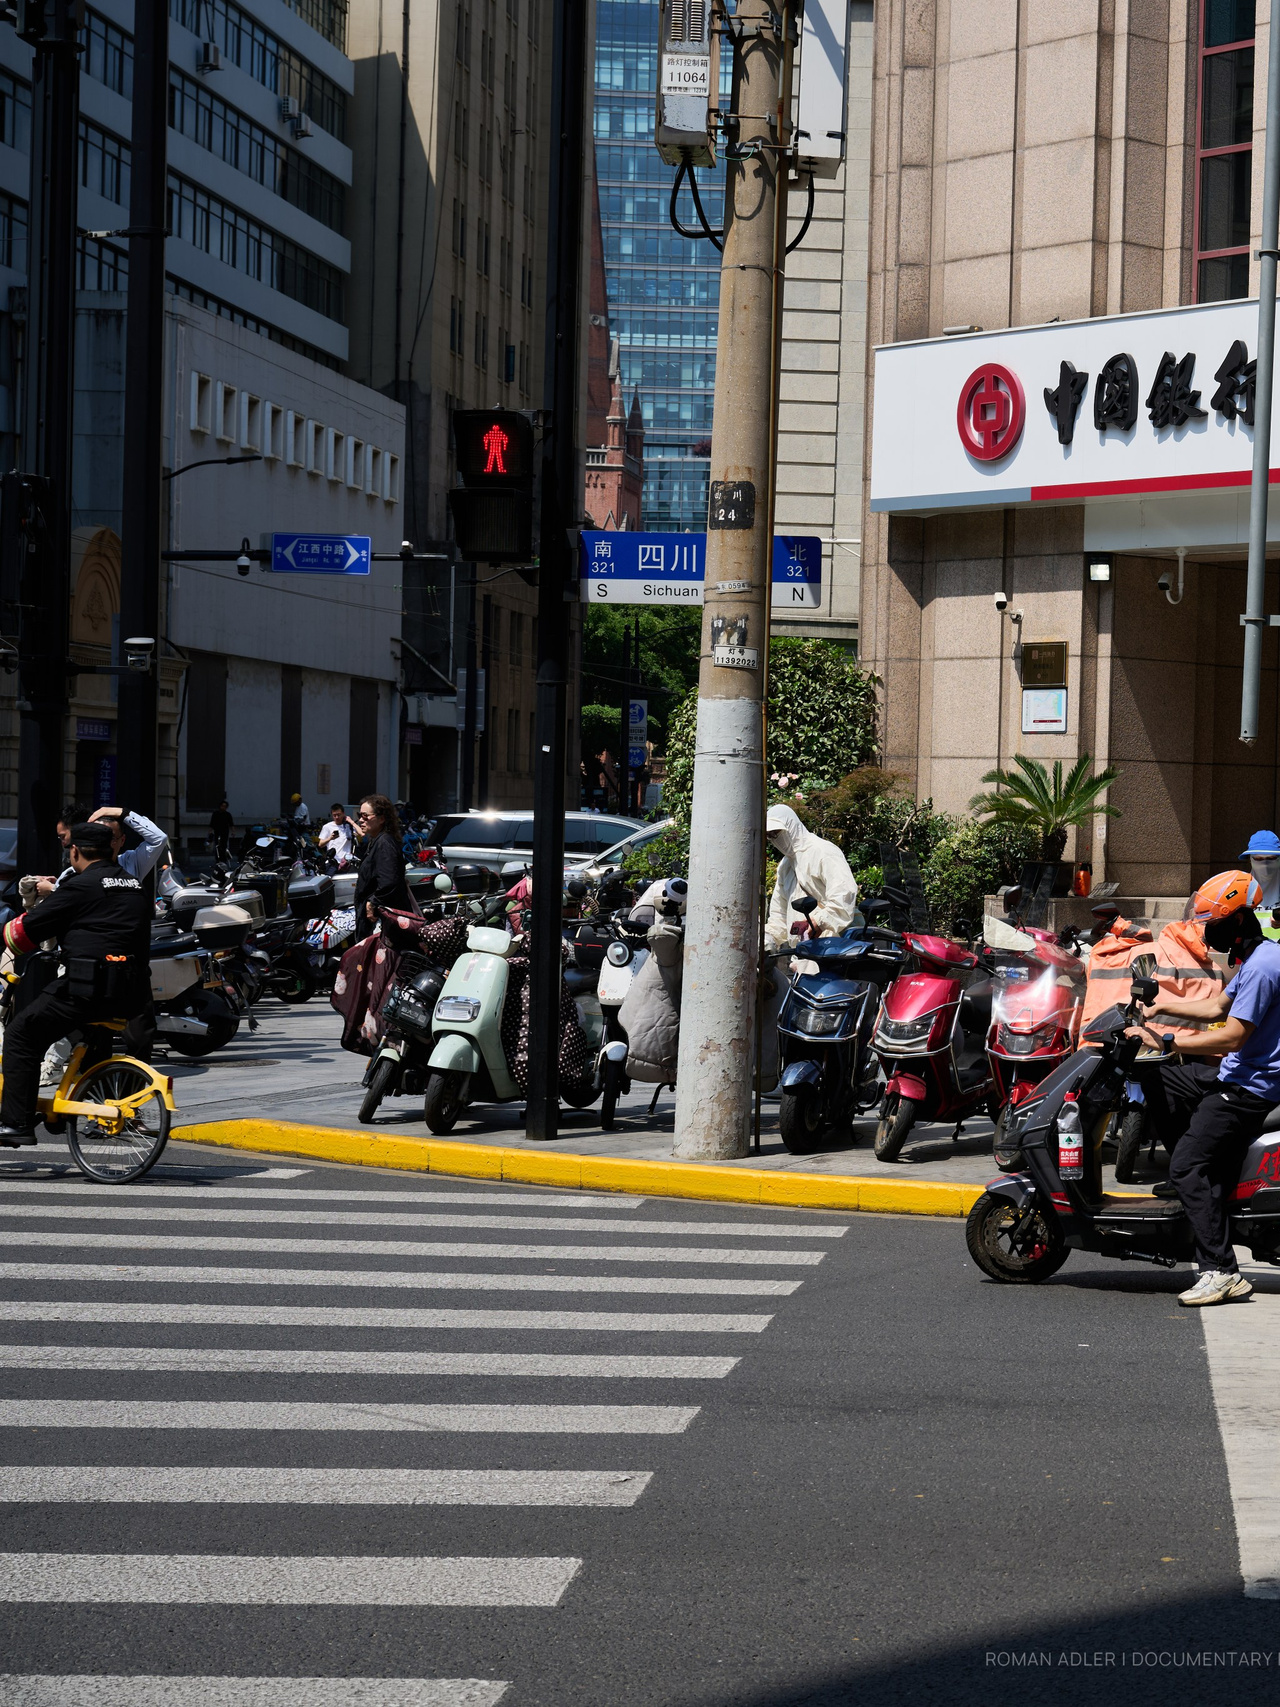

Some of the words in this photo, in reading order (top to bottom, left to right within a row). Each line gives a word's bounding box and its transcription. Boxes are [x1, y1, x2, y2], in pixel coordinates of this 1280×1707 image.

[667, 58, 708, 67] 路灯控制箱
[669, 72, 706, 83] 11064
[718, 508, 736, 521] 24
[298, 543, 345, 555] 江西中路
[594, 540, 612, 558] 南
[789, 544, 807, 562] 北
[638, 544, 697, 573] 四川
[591, 561, 615, 574] 321
[786, 565, 810, 577] 321
[596, 583, 608, 598] S
[643, 584, 699, 598] Sichuan
[792, 587, 805, 602] N
[728, 648, 746, 656] 灯号
[716, 657, 756, 667] 11392022
[99, 758, 111, 806] 九江停车
